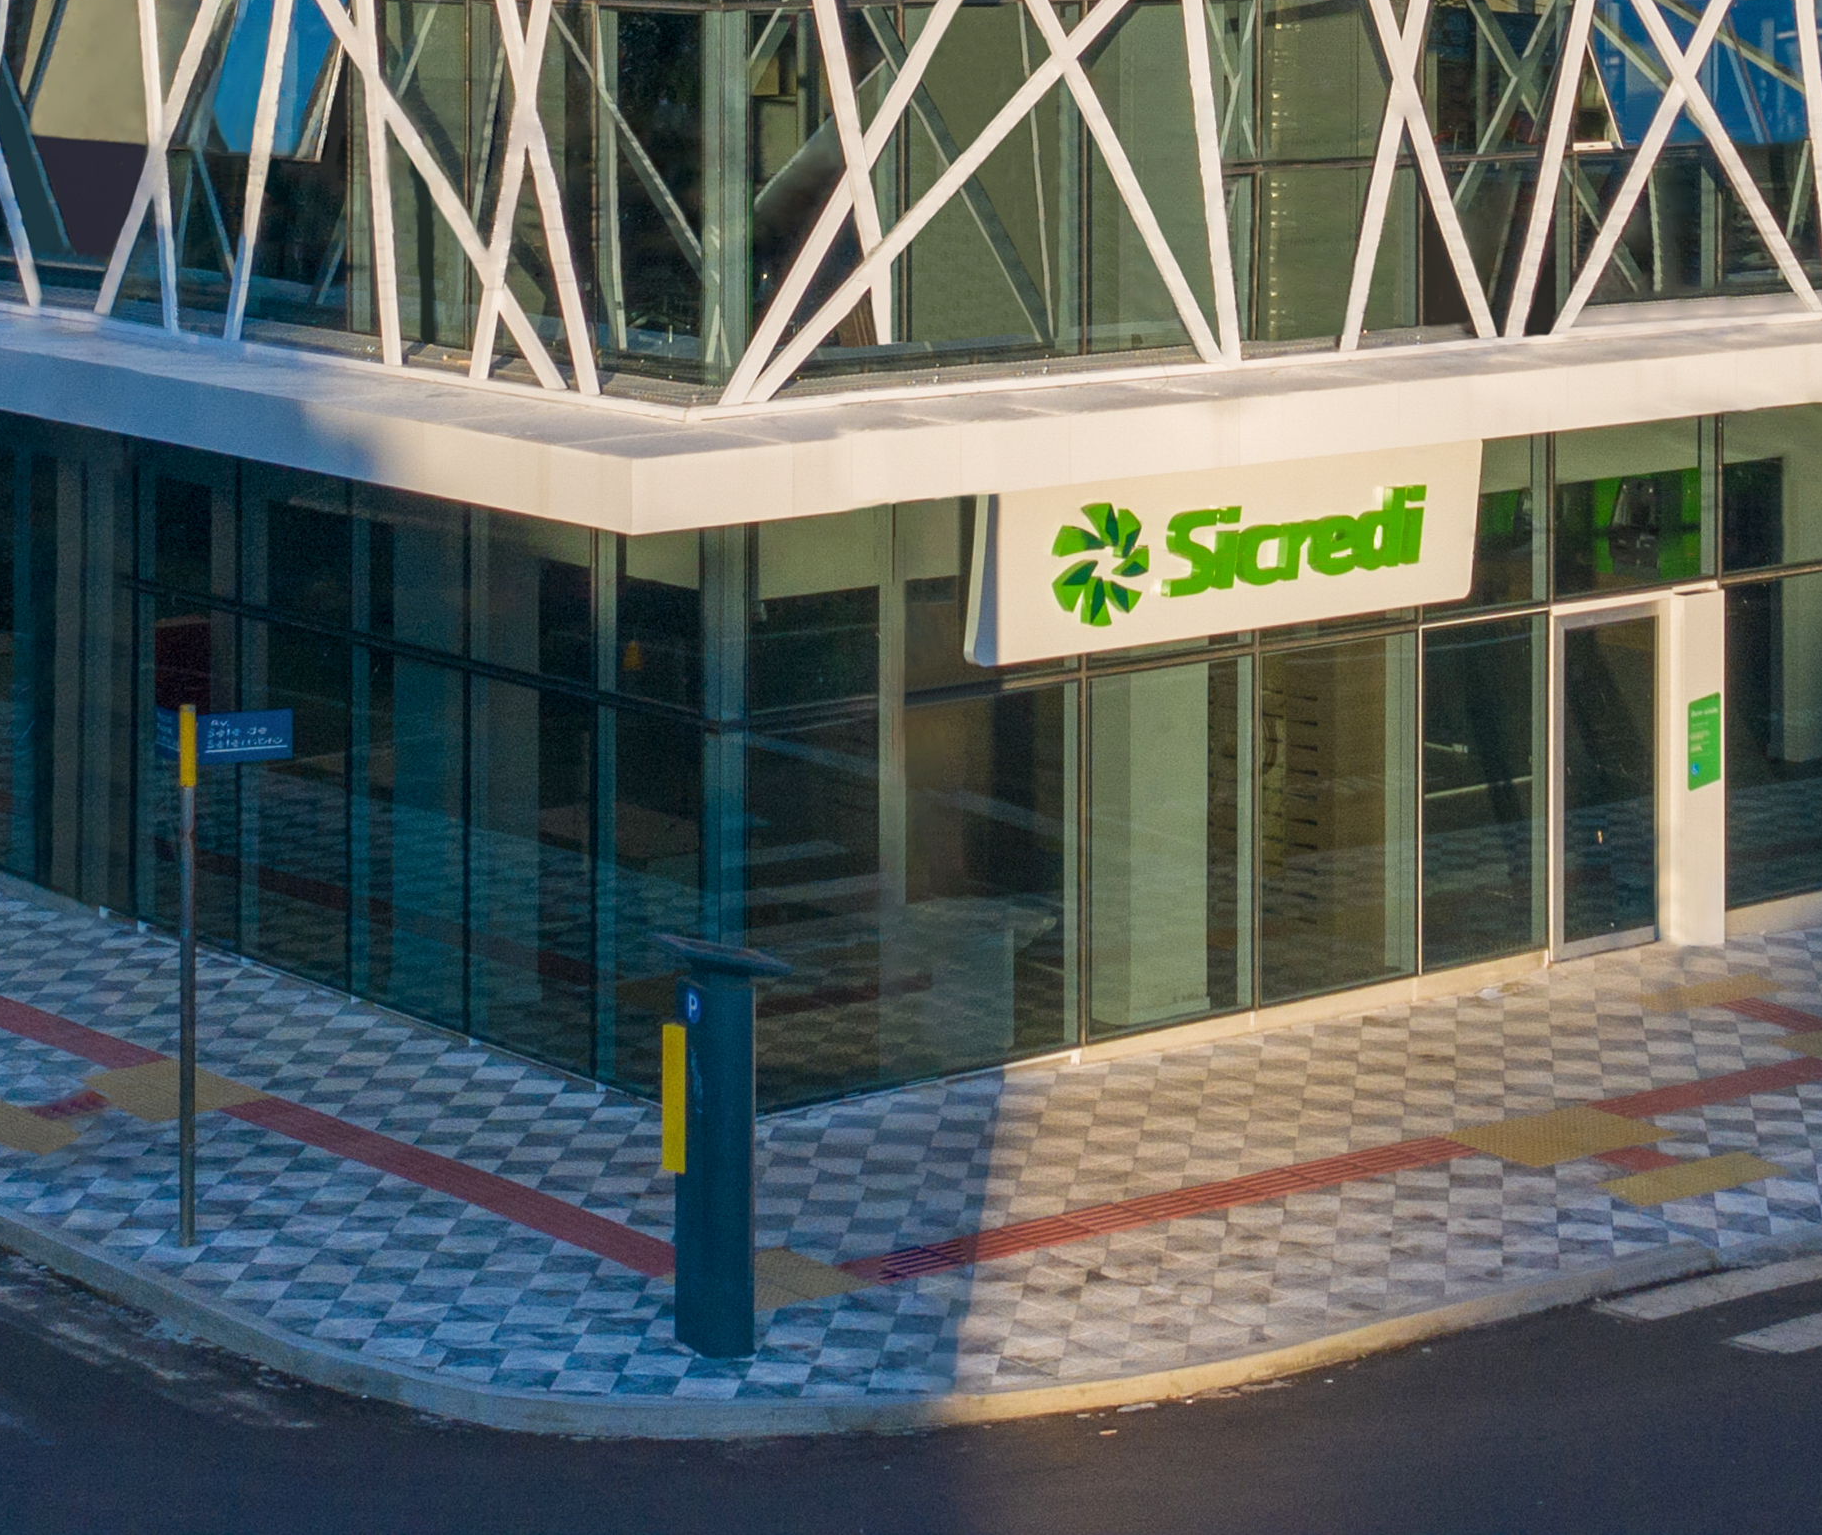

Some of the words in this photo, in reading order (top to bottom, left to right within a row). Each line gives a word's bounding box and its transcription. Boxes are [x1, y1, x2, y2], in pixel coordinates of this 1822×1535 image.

[1160, 484, 1427, 598] Sicredi
[247, 726, 268, 735] de
[688, 993, 698, 1017] P
